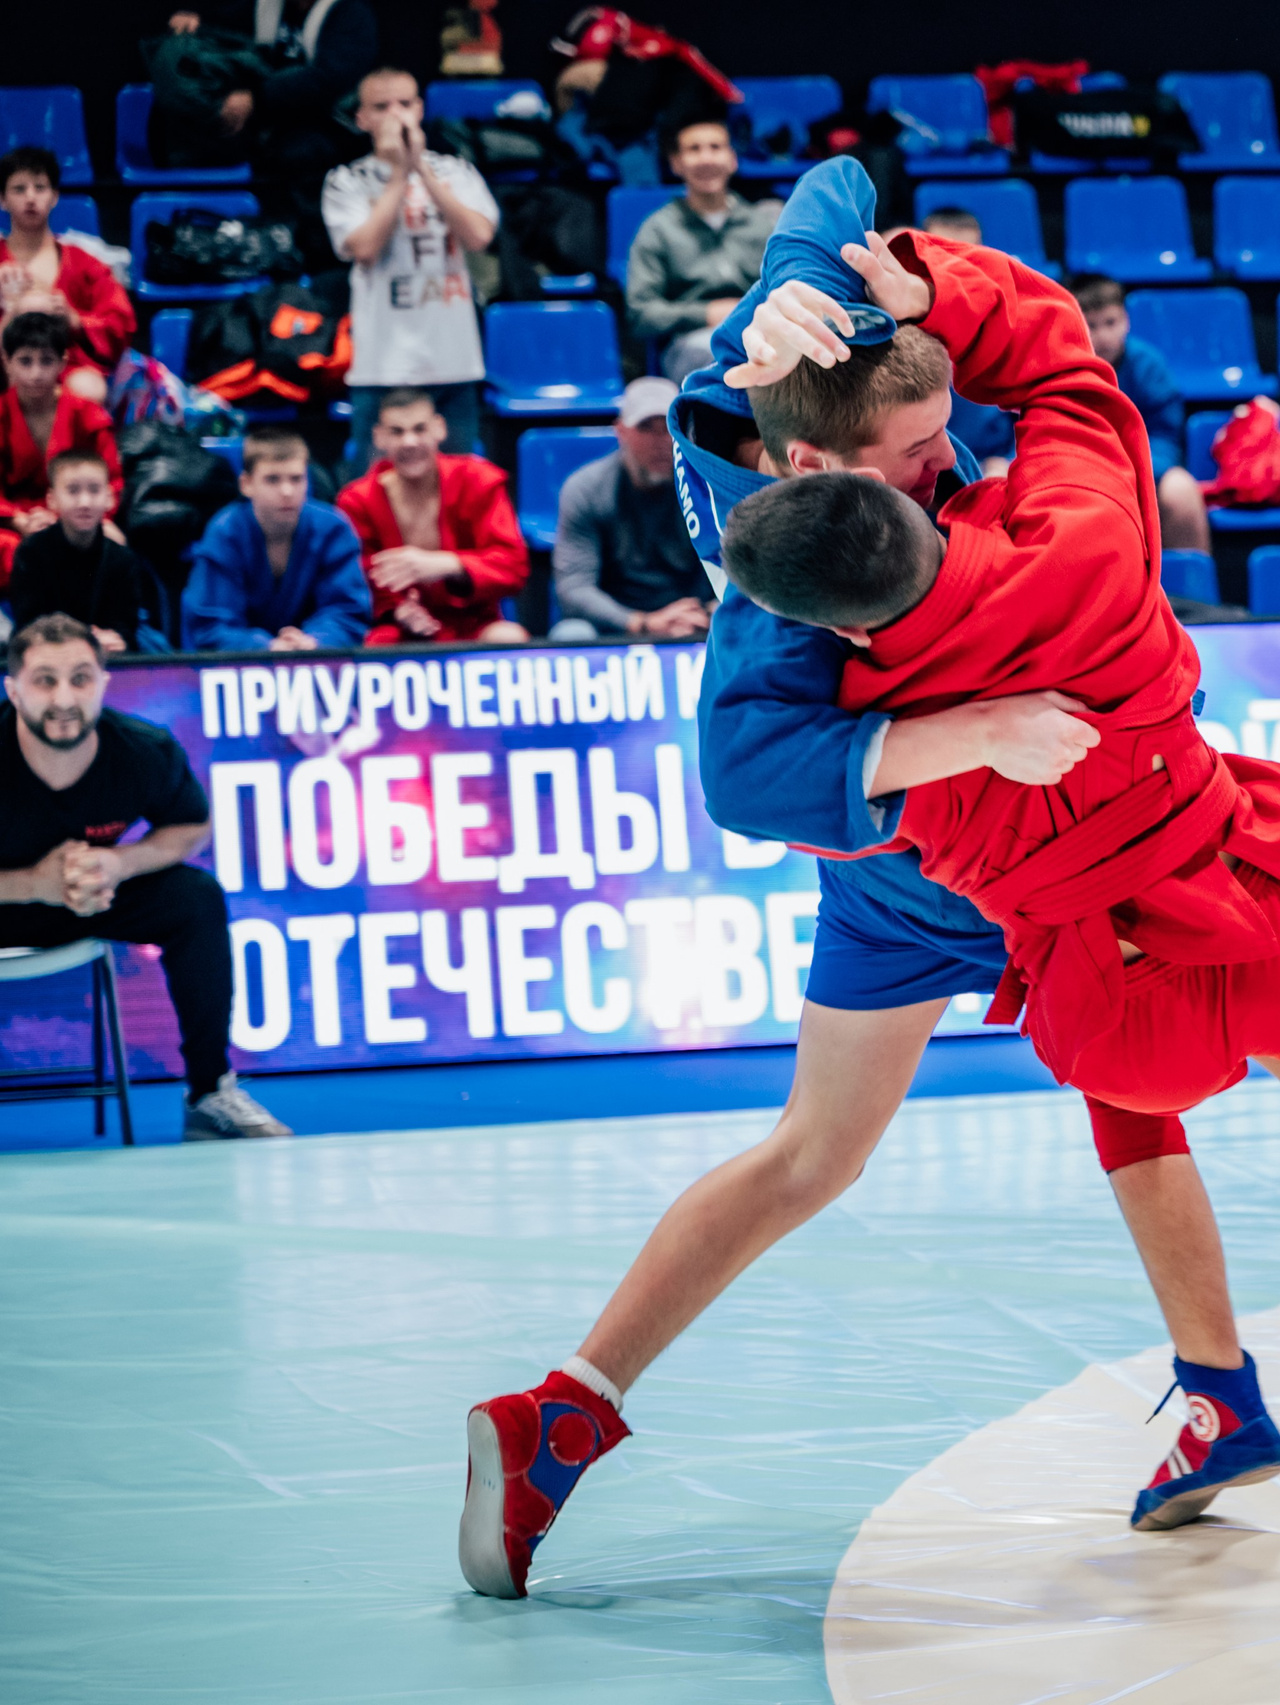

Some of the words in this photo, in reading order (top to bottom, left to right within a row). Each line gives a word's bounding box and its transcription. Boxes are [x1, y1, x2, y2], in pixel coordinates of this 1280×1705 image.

[200, 644, 666, 738] ПРИУРОЧЕННЫЙ
[210, 740, 692, 893] ПОБЕДЫ
[229, 892, 822, 1053] ОТЕЧЕСТВЕ
